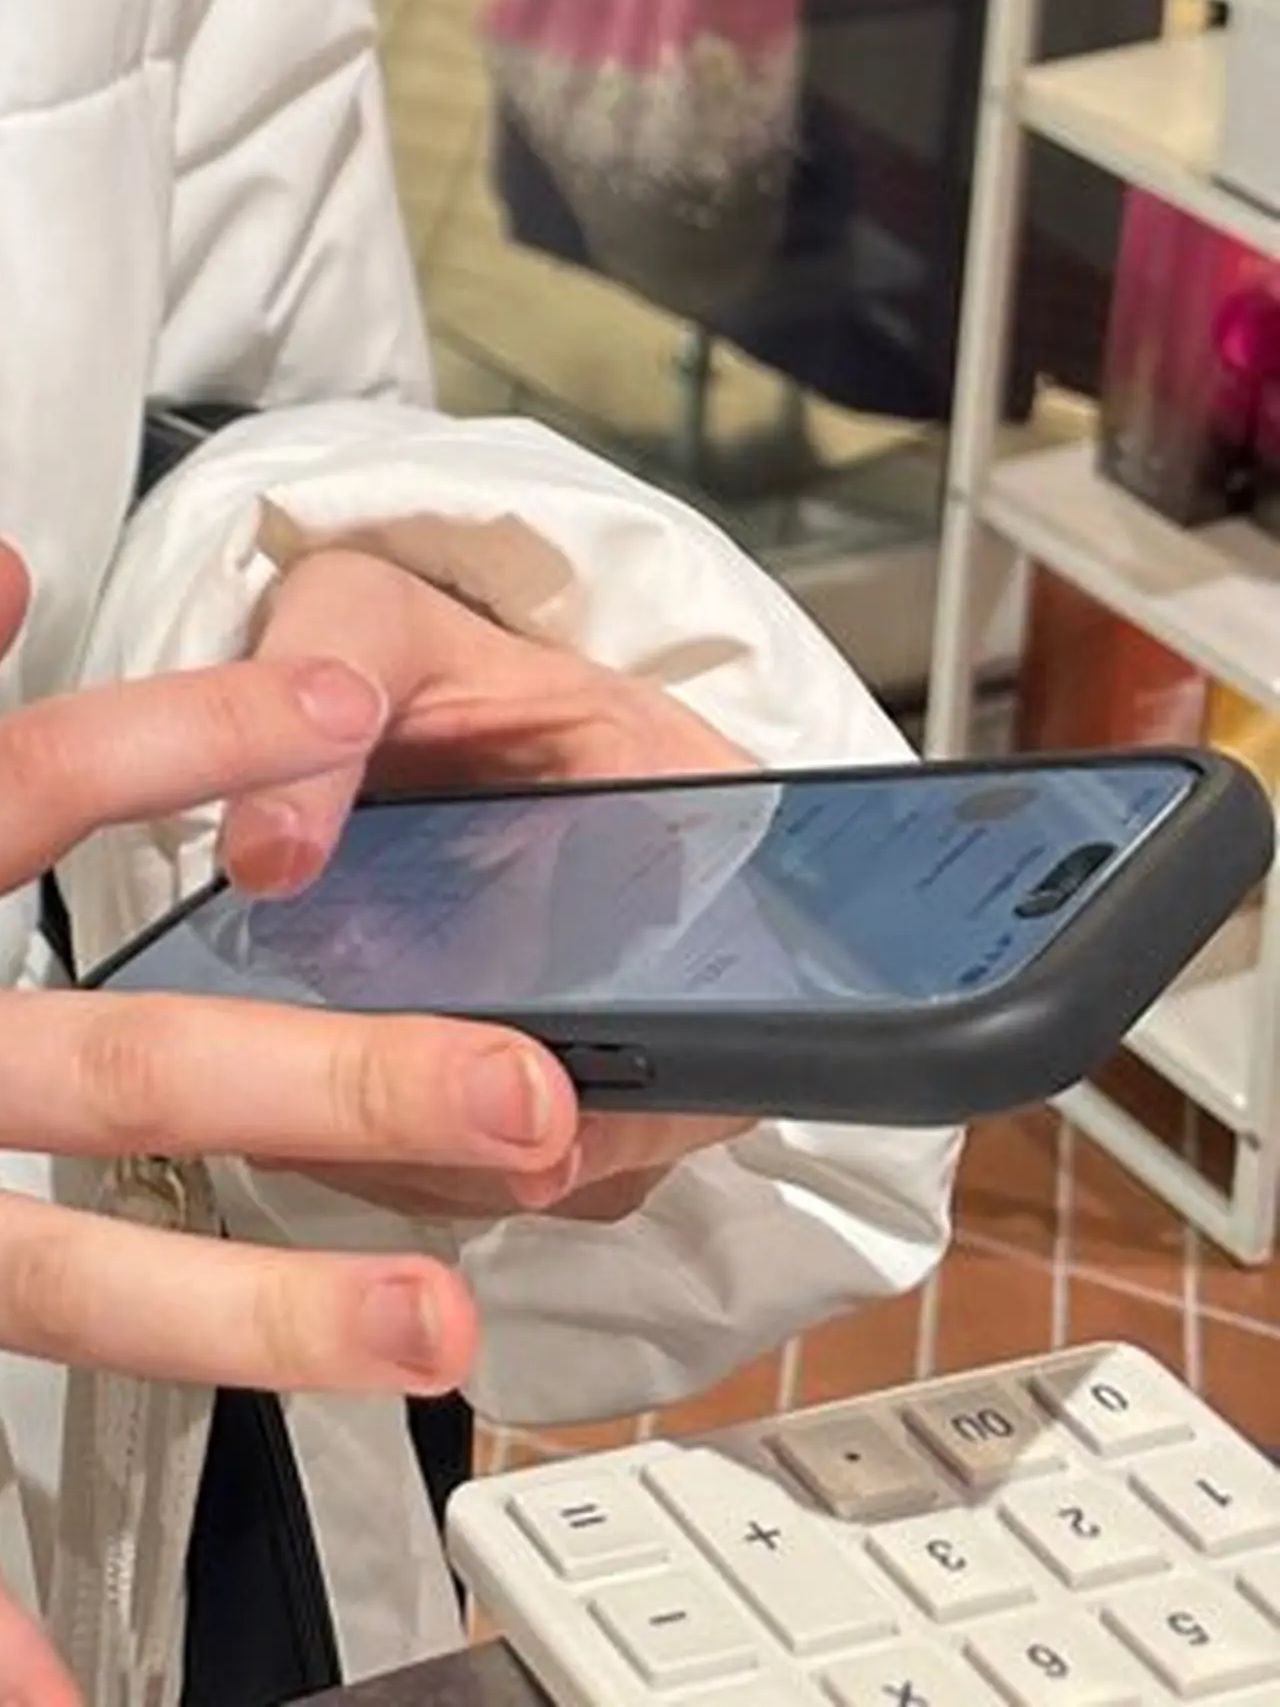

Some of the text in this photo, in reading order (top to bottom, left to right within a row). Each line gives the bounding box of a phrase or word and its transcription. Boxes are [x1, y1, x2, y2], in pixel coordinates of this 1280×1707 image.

[1091, 1384, 1128, 1412] 0
[951, 1409, 1014, 1442] 00
[1196, 1479, 1232, 1508] 1
[1058, 1507, 1101, 1537] 2
[926, 1539, 966, 1571] 3
[1167, 1611, 1210, 1646] 5
[1027, 1644, 1068, 1679] 6
